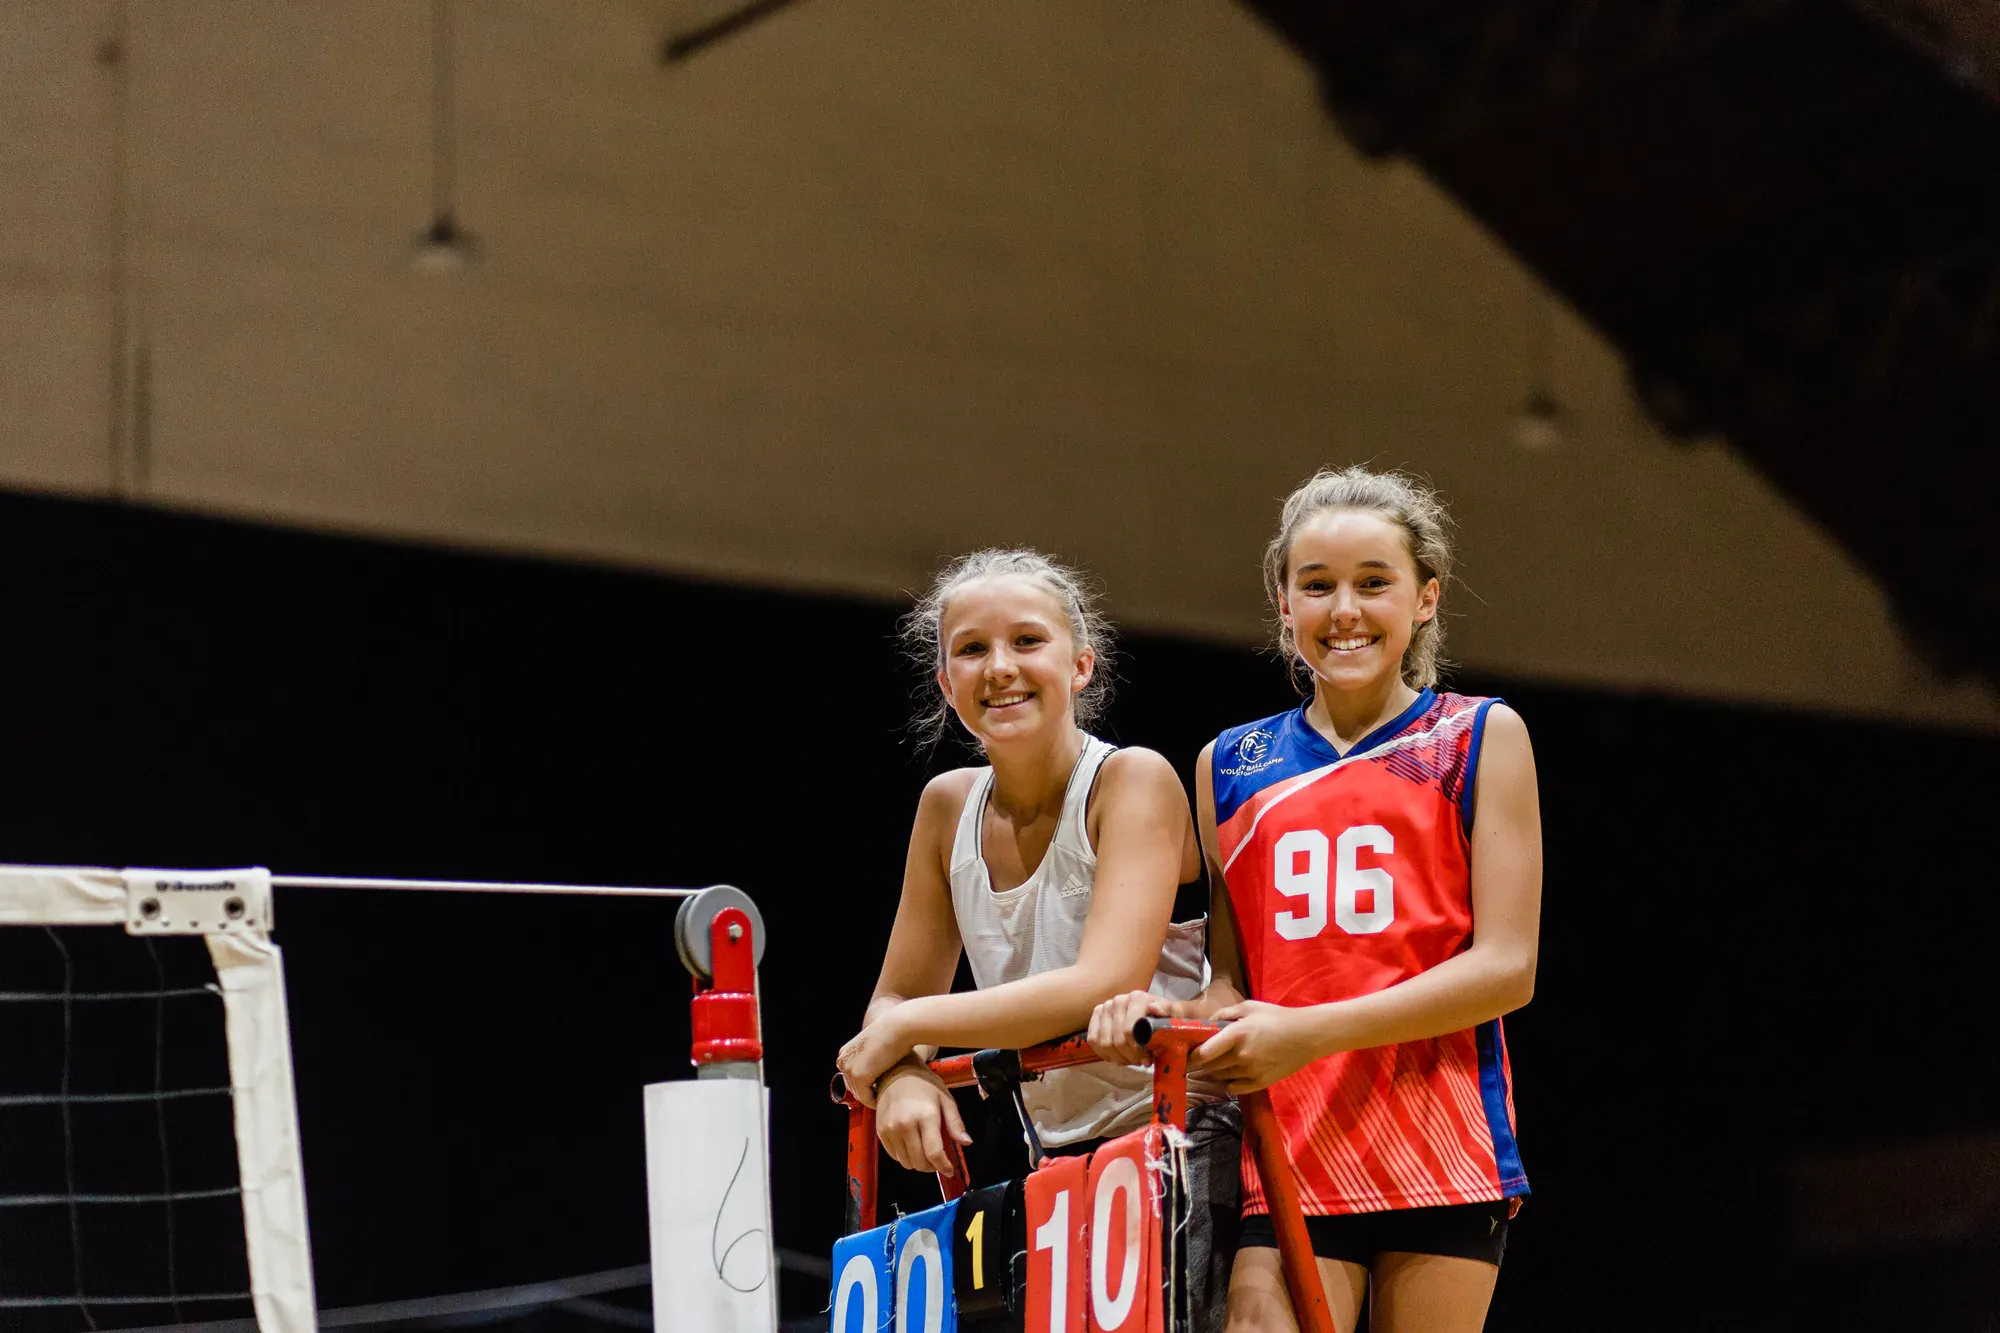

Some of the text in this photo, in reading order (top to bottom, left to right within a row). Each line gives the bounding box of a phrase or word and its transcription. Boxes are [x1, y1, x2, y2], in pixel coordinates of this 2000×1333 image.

[1220, 763, 1262, 775] VOLYBALL
[1263, 758, 1284, 768] CAMP
[1274, 825, 1395, 941] 96
[965, 1210, 985, 1290] 1
[1036, 1157, 1141, 1333] 10
